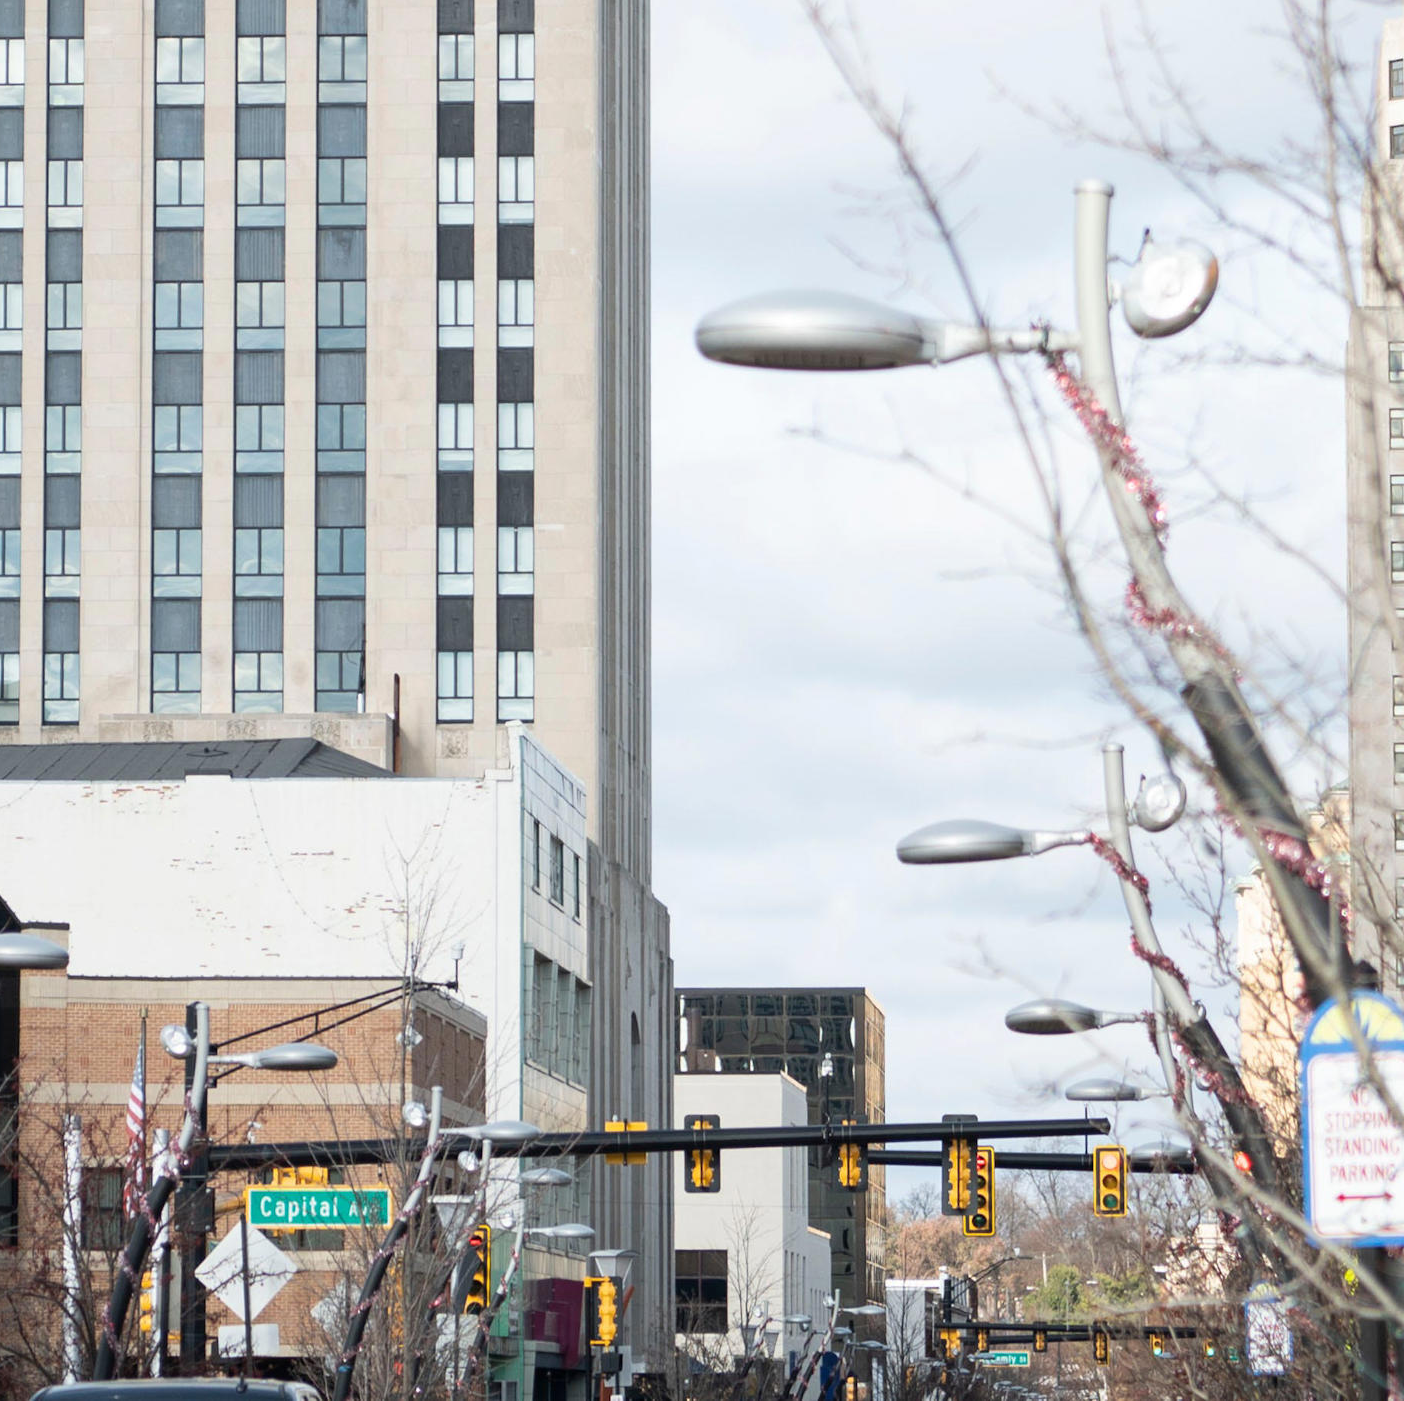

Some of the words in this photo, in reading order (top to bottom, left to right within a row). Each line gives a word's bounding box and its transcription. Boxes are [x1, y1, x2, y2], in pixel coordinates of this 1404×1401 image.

[1324, 1111, 1399, 1133] STOPPIN
[1324, 1136, 1400, 1158] STANDING
[1330, 1163, 1397, 1183] PARKING
[260, 1196, 338, 1223] Capital
